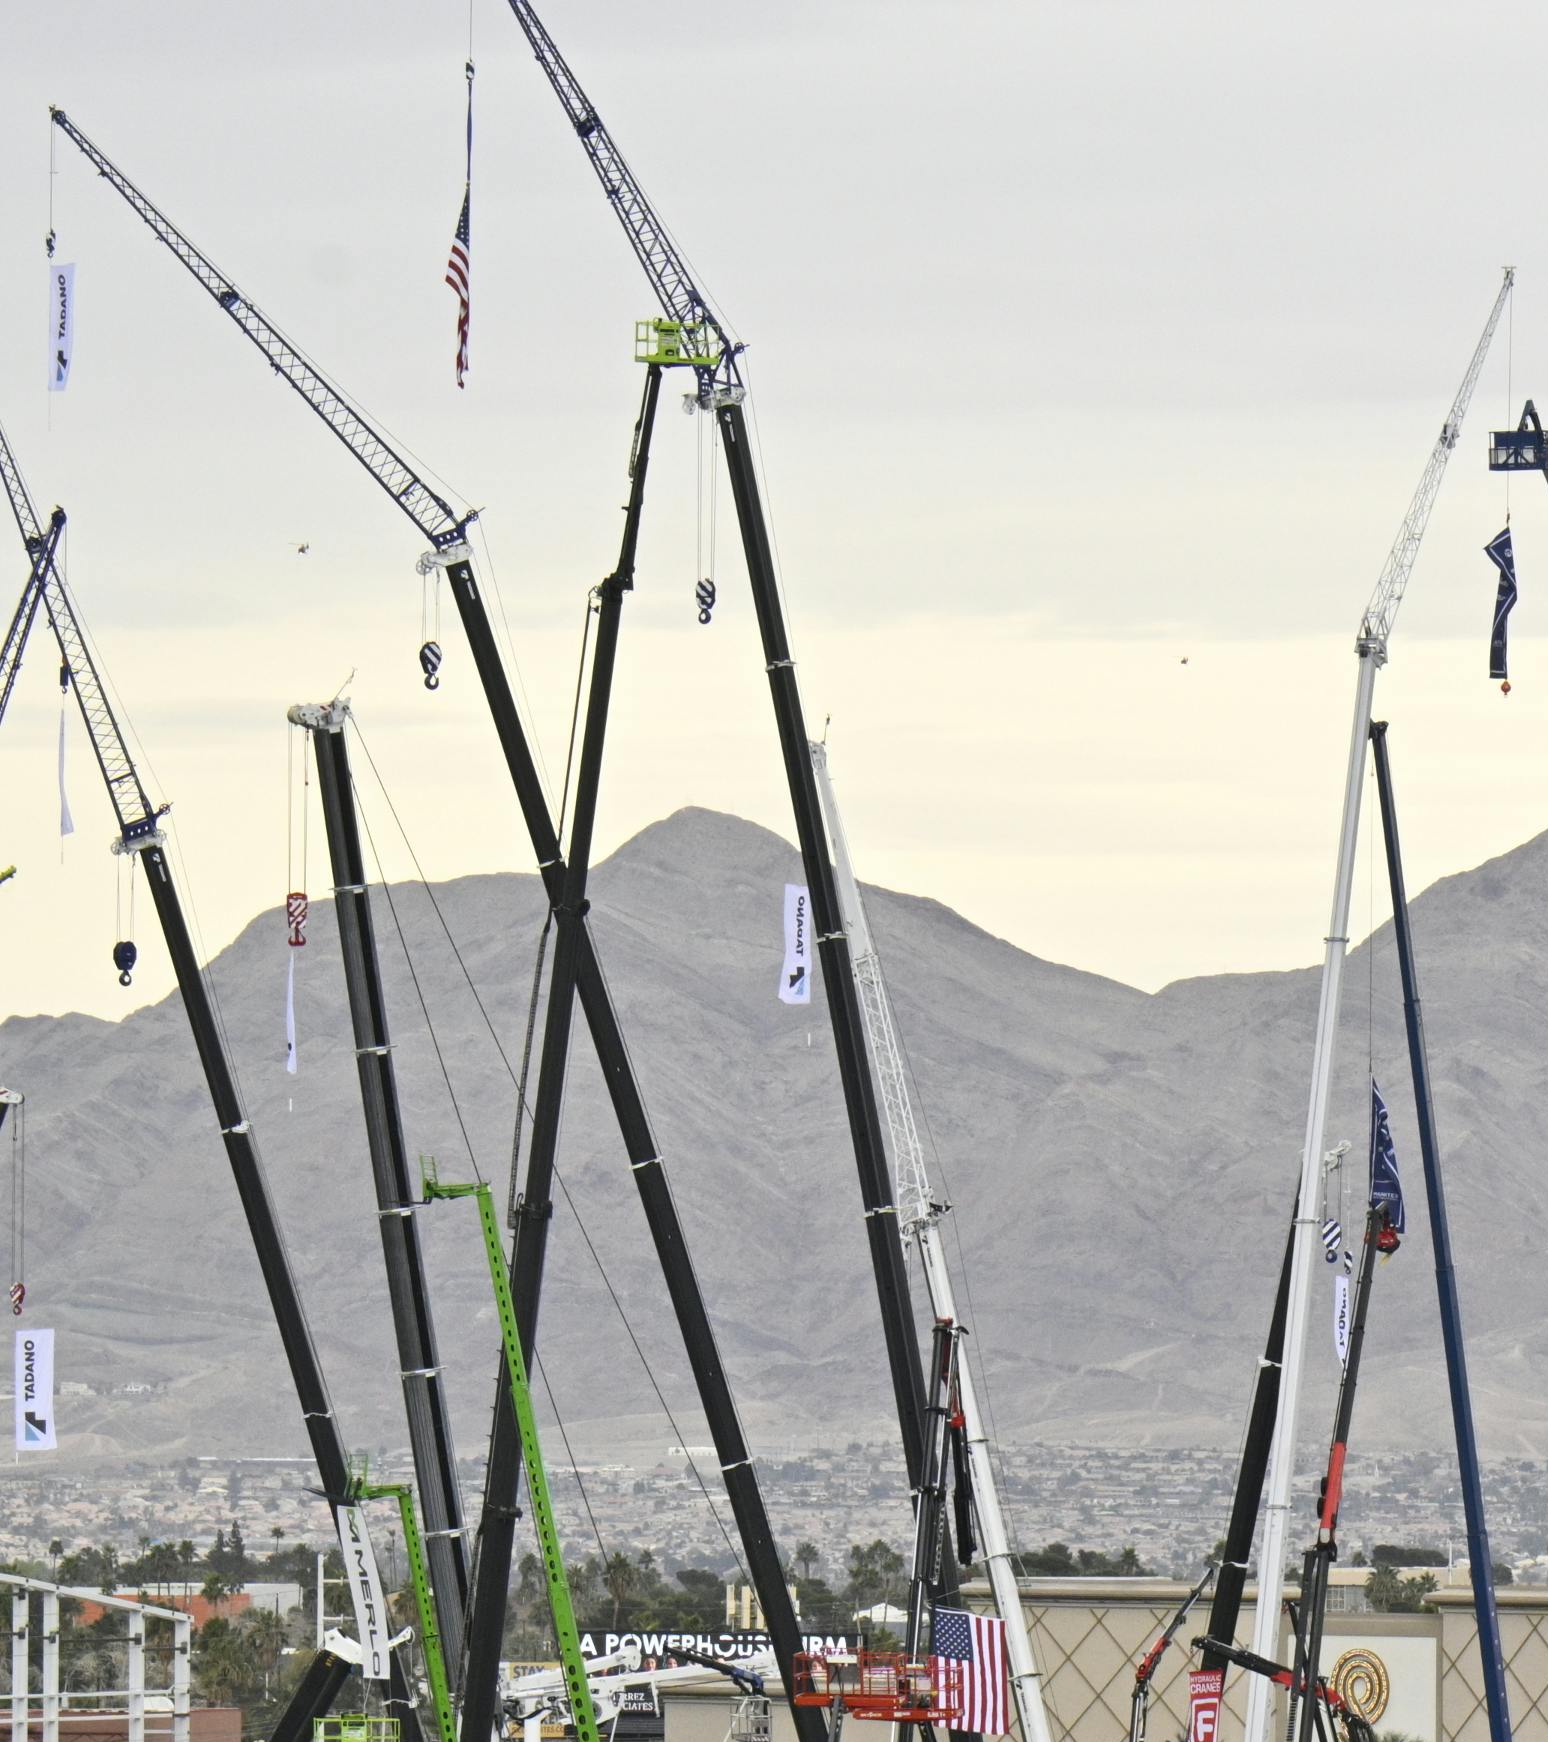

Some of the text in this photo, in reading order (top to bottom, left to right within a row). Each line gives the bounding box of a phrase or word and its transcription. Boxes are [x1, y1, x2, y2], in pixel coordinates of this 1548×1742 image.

[57, 274, 65, 338] TADANO
[25, 1339, 34, 1401] TADANO
[354, 1549, 383, 1677] MERLO
[1190, 1681, 1222, 1694] CRANES
